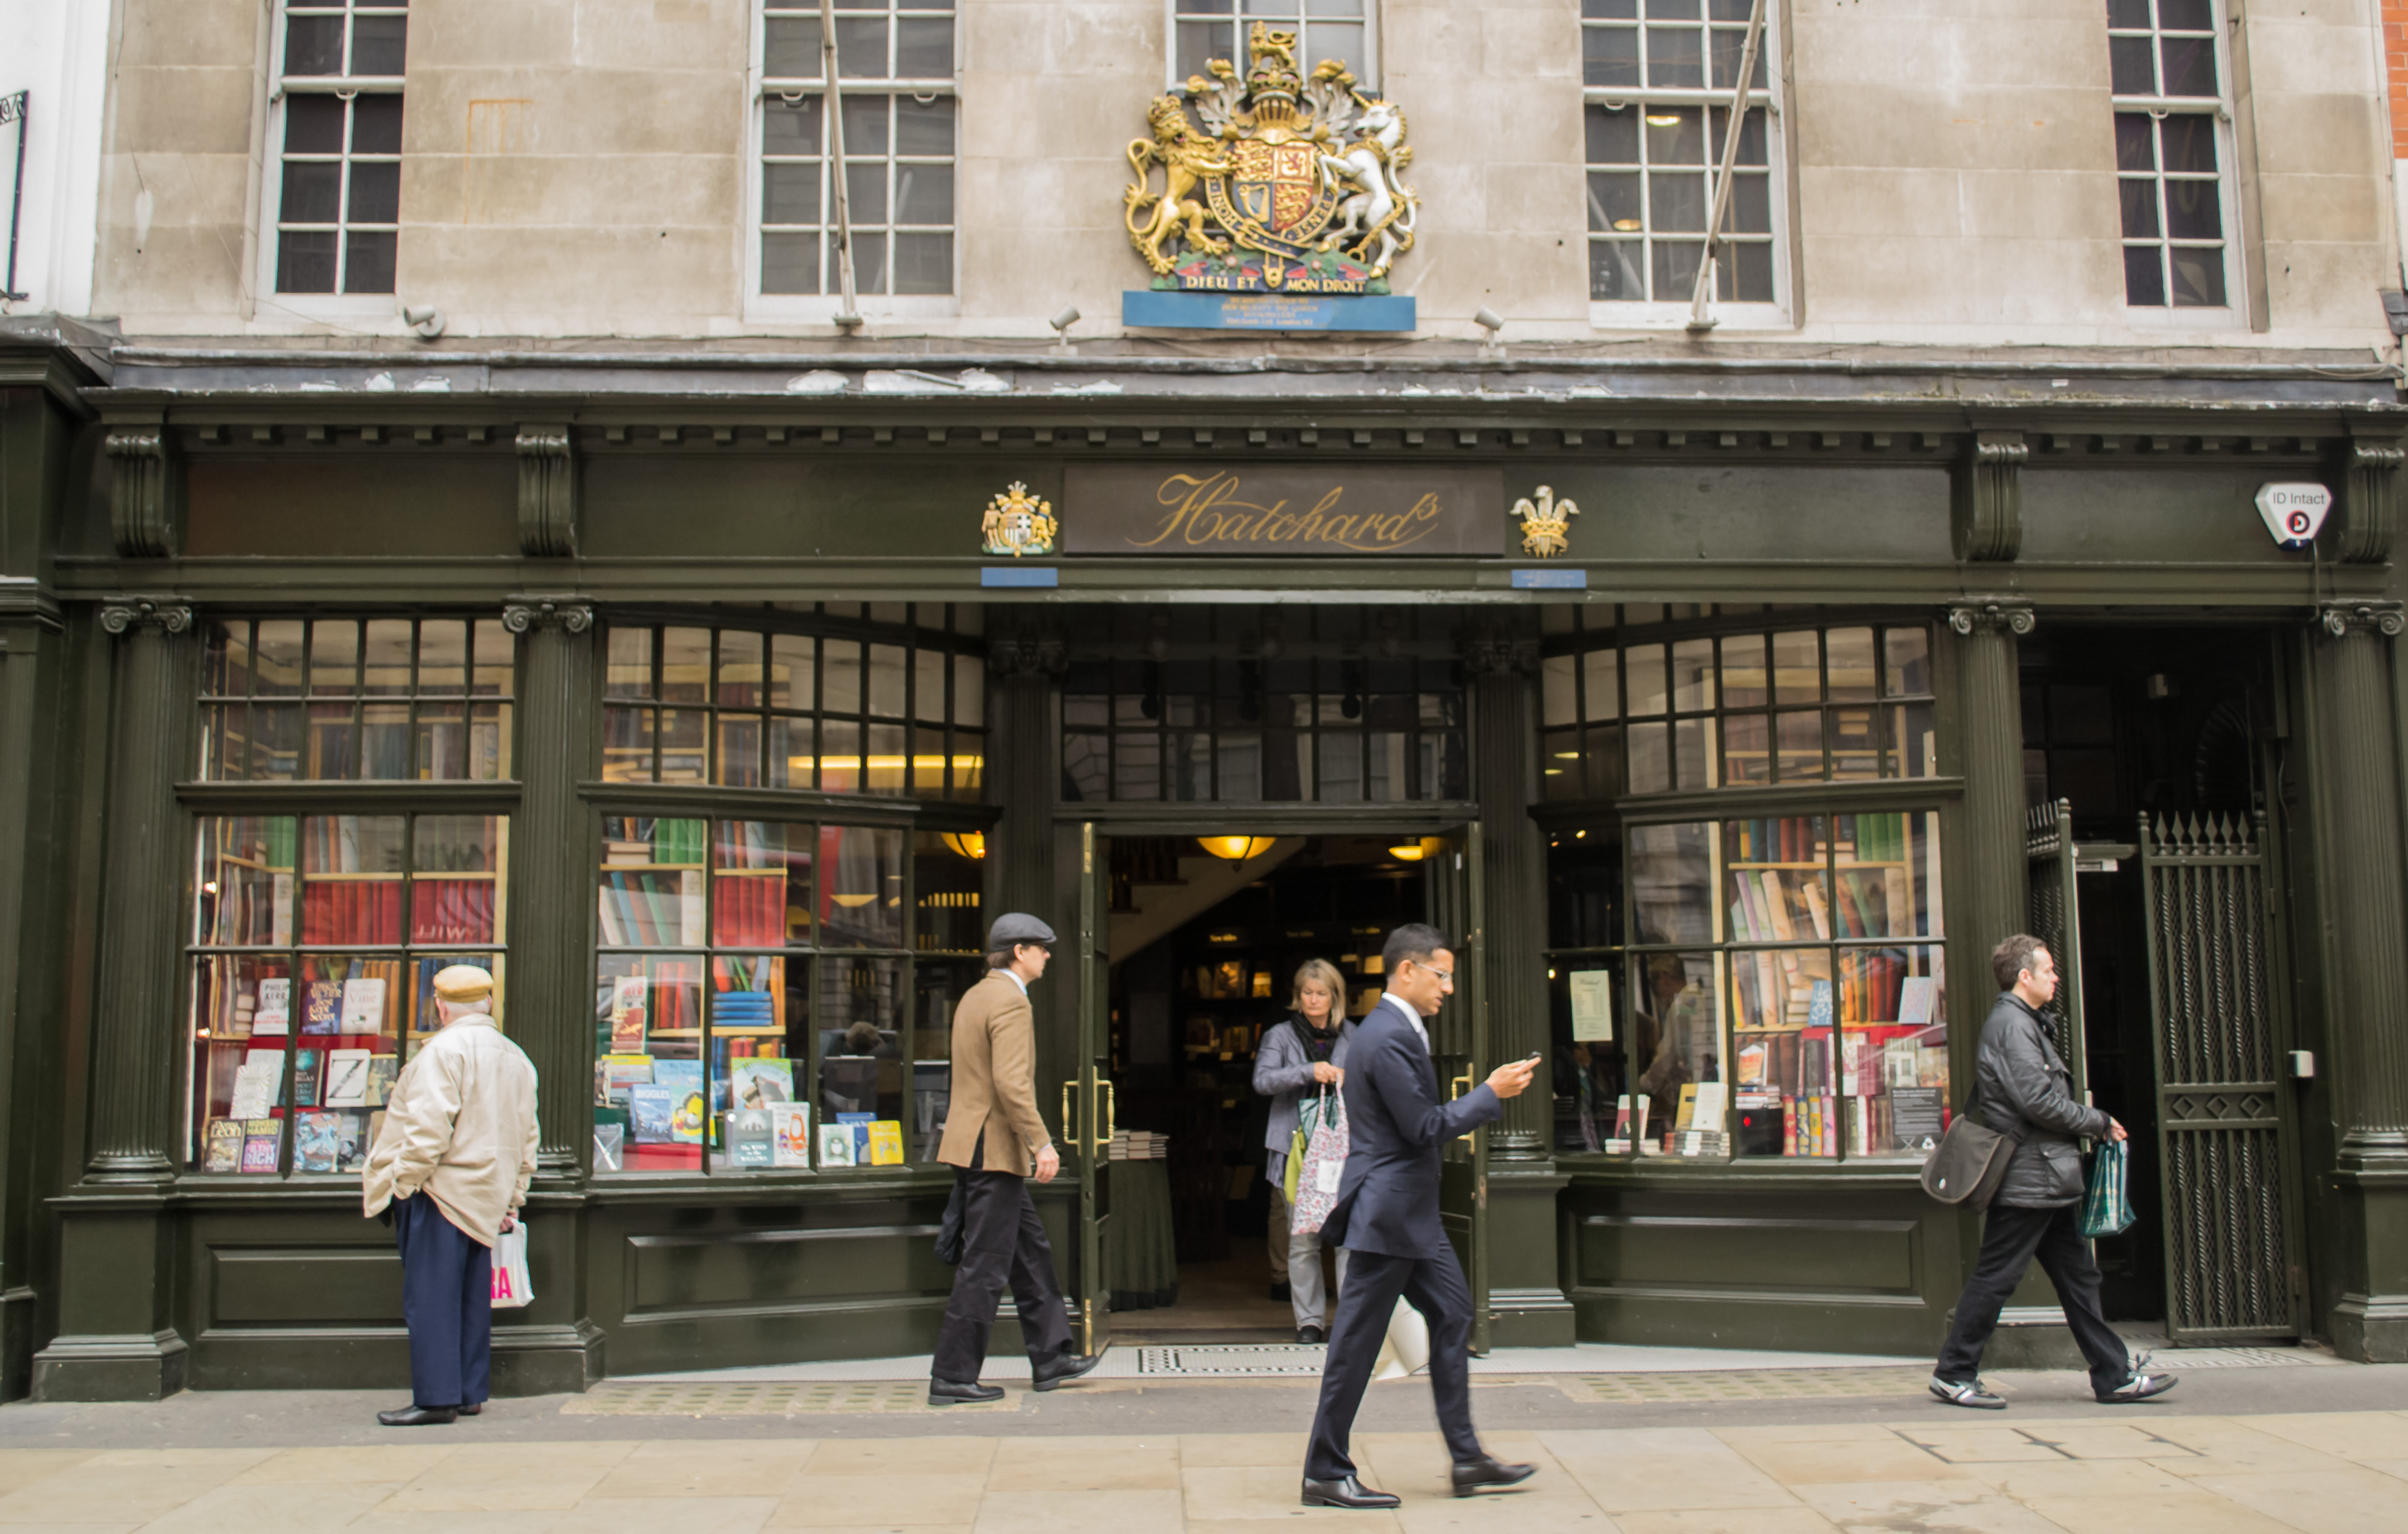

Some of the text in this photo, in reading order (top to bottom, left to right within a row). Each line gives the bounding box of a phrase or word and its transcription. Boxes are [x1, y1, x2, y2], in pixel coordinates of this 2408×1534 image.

[1294, 199, 1333, 239] PENSE
[1186, 276, 1258, 290] DIEU ET
[1286, 279, 1366, 293] MON DROIT
[2273, 492, 2325, 505] ID Intact
[349, 993, 377, 1003] Vine
[327, 1059, 366, 1098] Z
[635, 1089, 670, 1099] BIGGLES
[246, 1126, 278, 1135] HAMID
[244, 1153, 275, 1165] RICH
